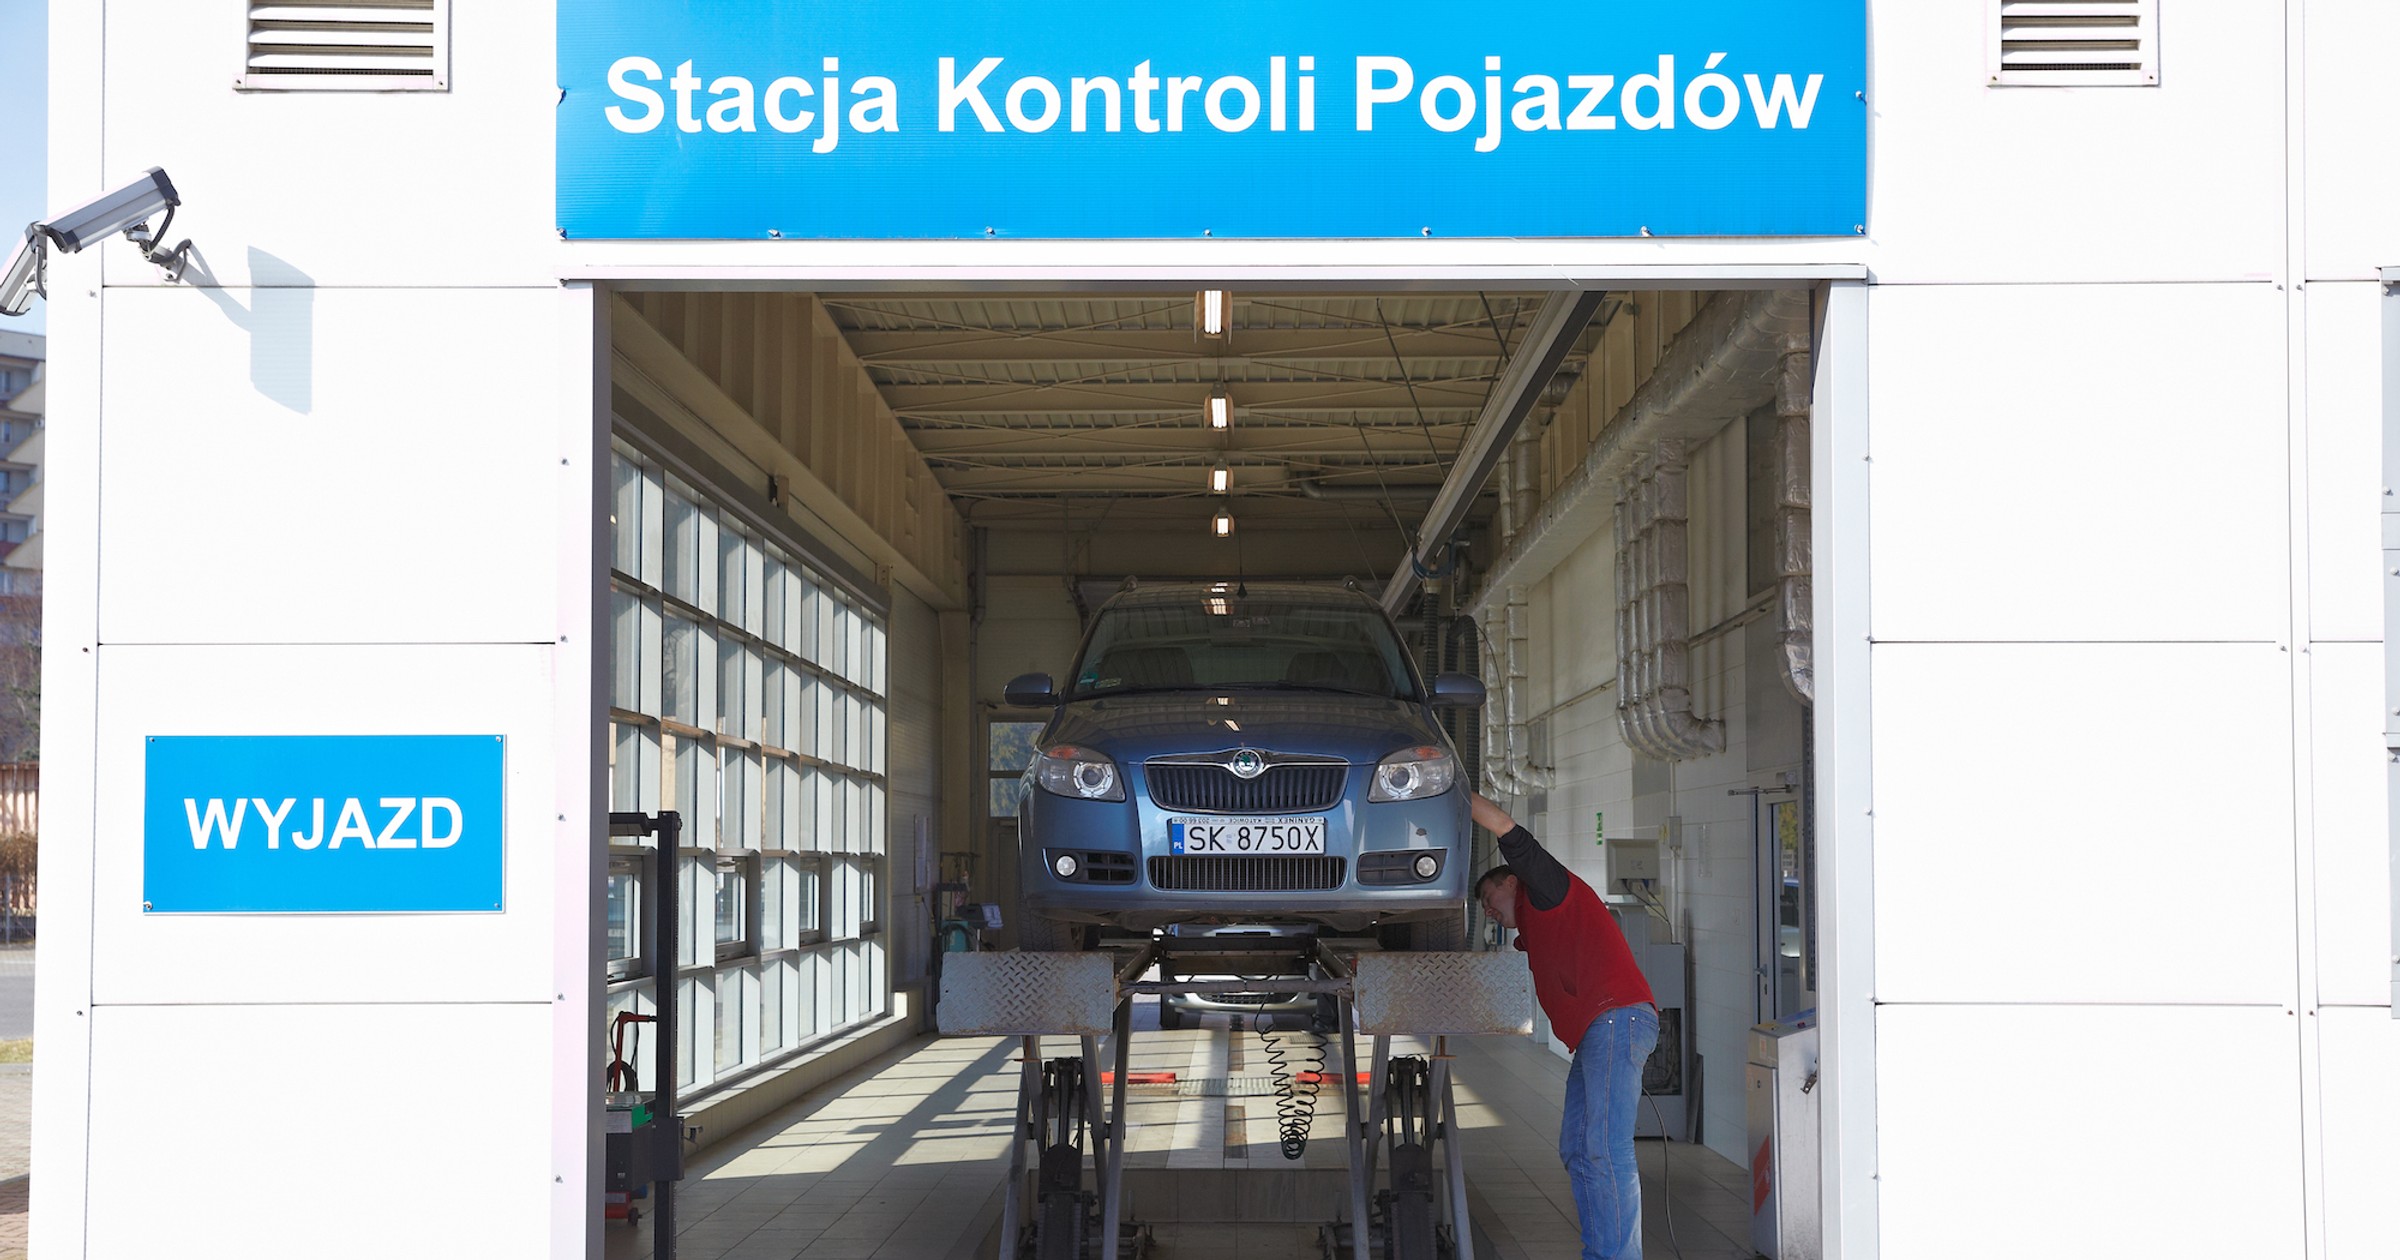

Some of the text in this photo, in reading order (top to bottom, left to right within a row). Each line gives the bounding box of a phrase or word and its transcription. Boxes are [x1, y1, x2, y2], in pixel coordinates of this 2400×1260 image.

[604, 52, 1825, 153] Stacja Kontroli Pojazdów
[184, 797, 463, 851] WYJAZD
[1189, 826, 1319, 851] SK 8750X
[1173, 841, 1183, 850] PL
